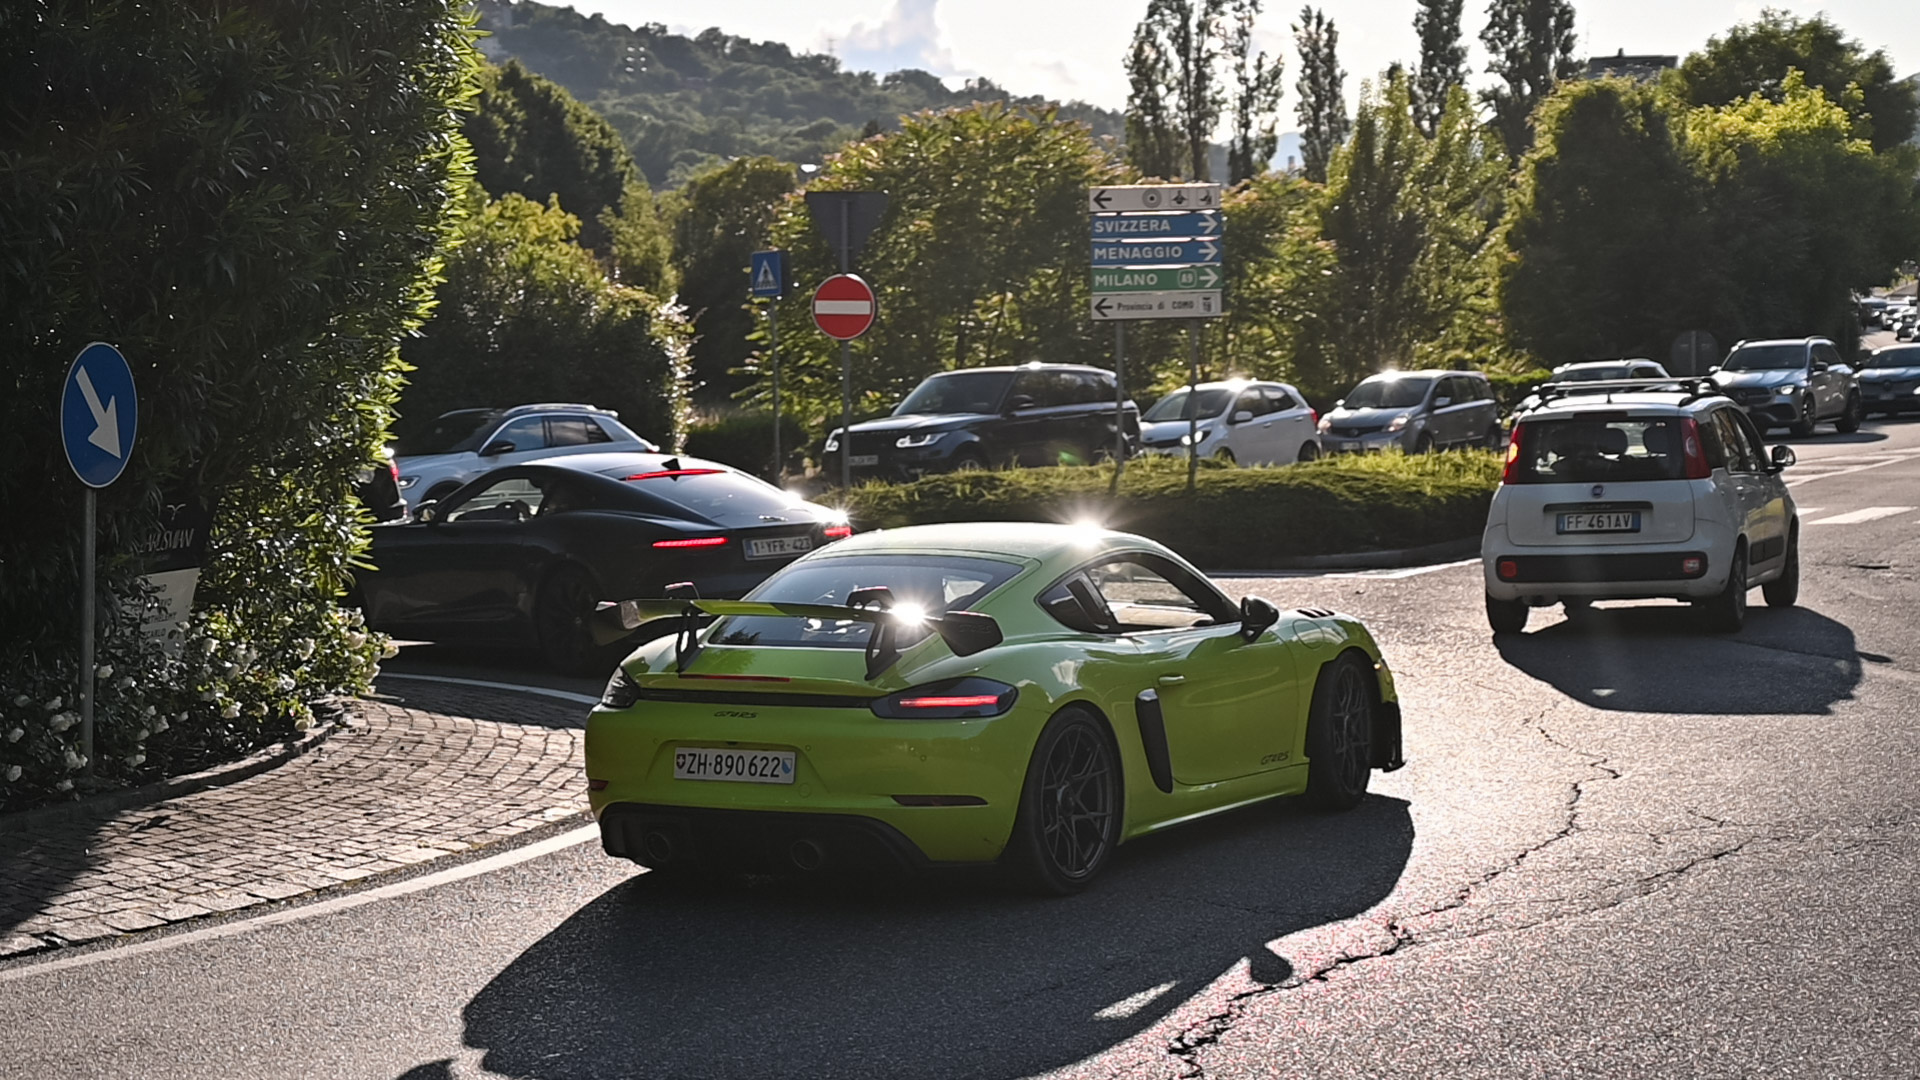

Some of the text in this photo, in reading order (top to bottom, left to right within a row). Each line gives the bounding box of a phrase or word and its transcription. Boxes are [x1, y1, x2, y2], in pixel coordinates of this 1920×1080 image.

[1094, 219, 1171, 233] SVIZZERA
[1094, 246, 1182, 260] MENAGGIO
[1094, 273, 1158, 287] MILANO
